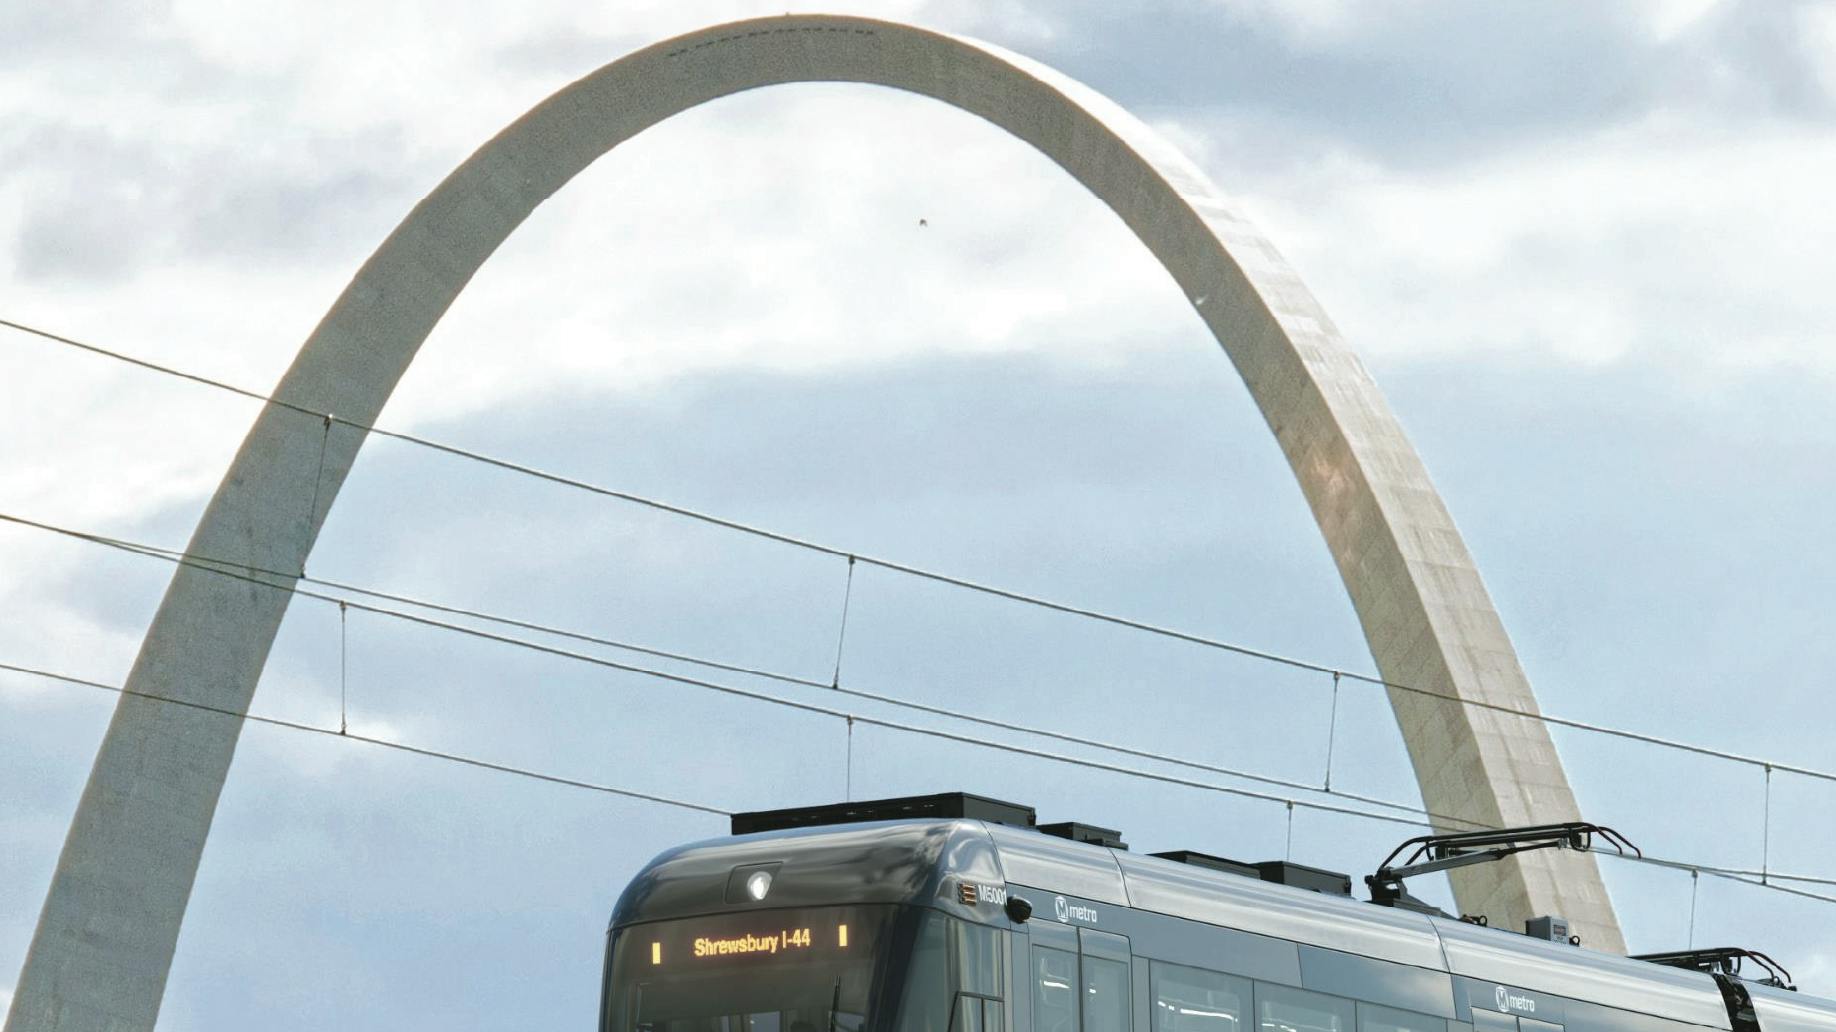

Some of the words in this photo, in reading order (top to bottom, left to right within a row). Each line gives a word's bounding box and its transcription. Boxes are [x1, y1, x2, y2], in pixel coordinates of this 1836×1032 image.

[978, 884, 1007, 906] M5001
[1069, 905, 1098, 923] metro
[694, 933, 779, 957] Shrewsbury
[782, 928, 811, 949] I-44
[1509, 995, 1535, 1012] metro
